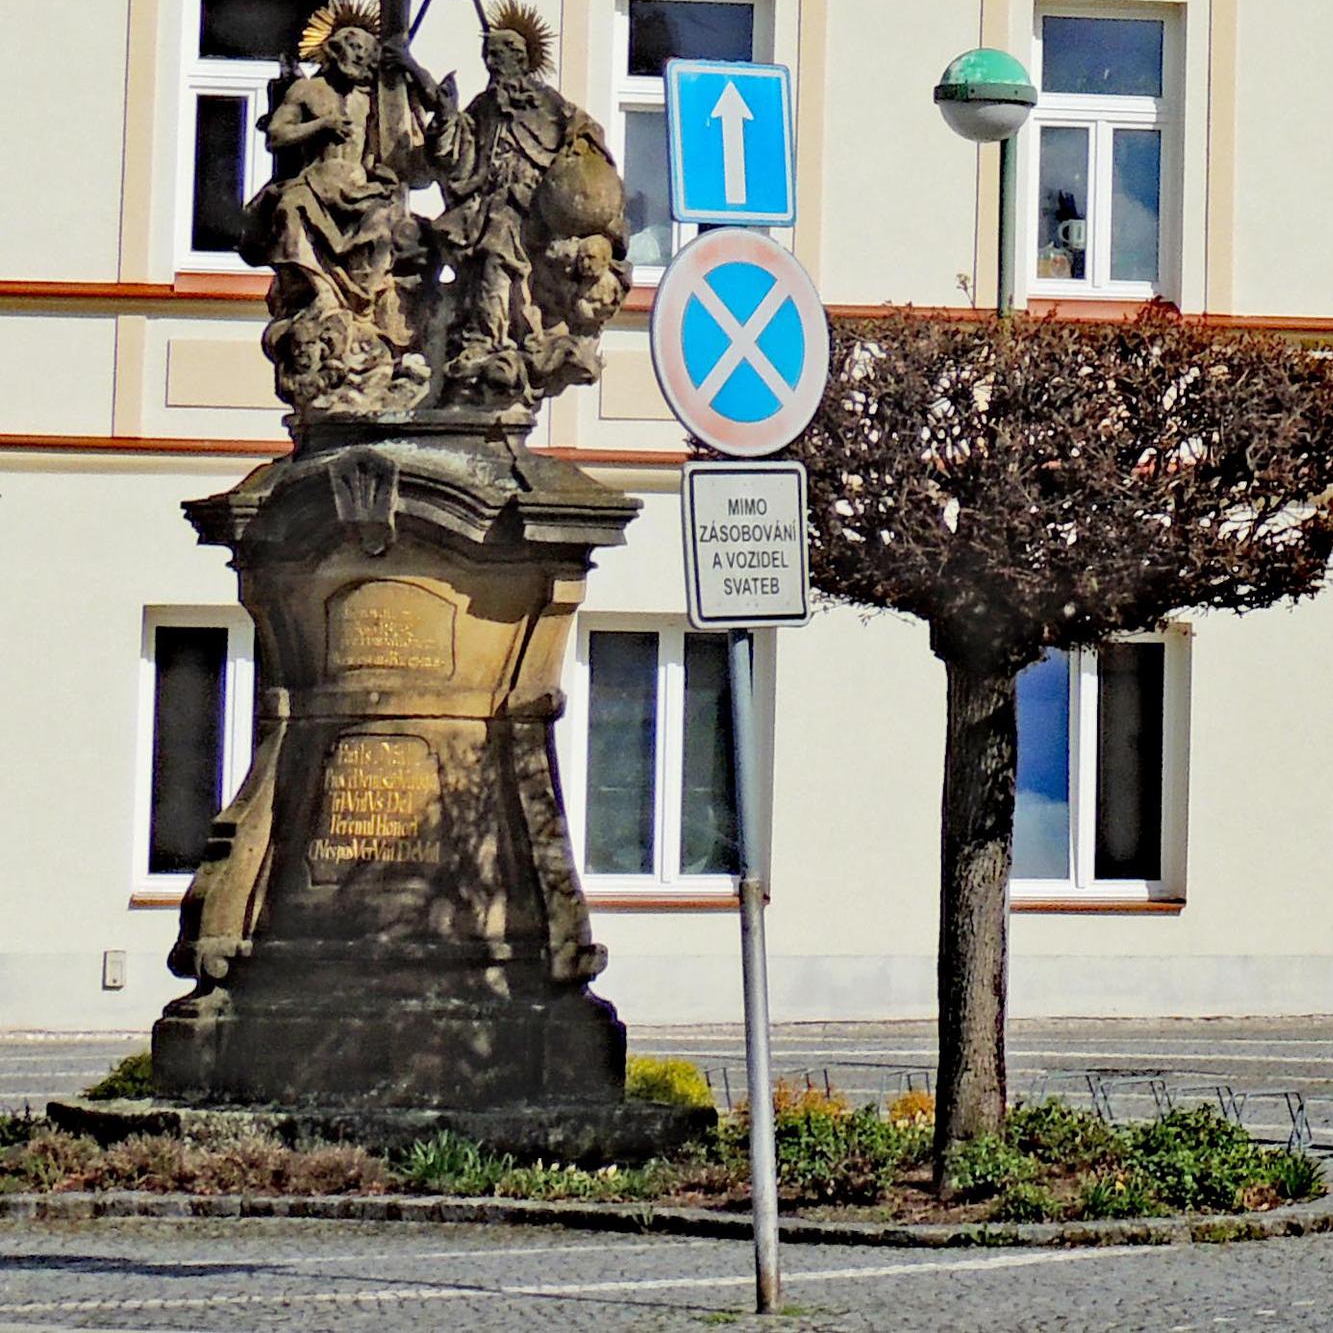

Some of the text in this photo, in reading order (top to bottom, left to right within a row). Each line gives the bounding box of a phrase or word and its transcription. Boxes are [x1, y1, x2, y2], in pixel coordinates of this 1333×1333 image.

[728, 498, 768, 517] MIMO
[699, 520, 797, 543] ZÁSOBOVÁNÍ
[713, 551, 789, 569] A VOZIDEL
[724, 577, 780, 596] SVATEB
